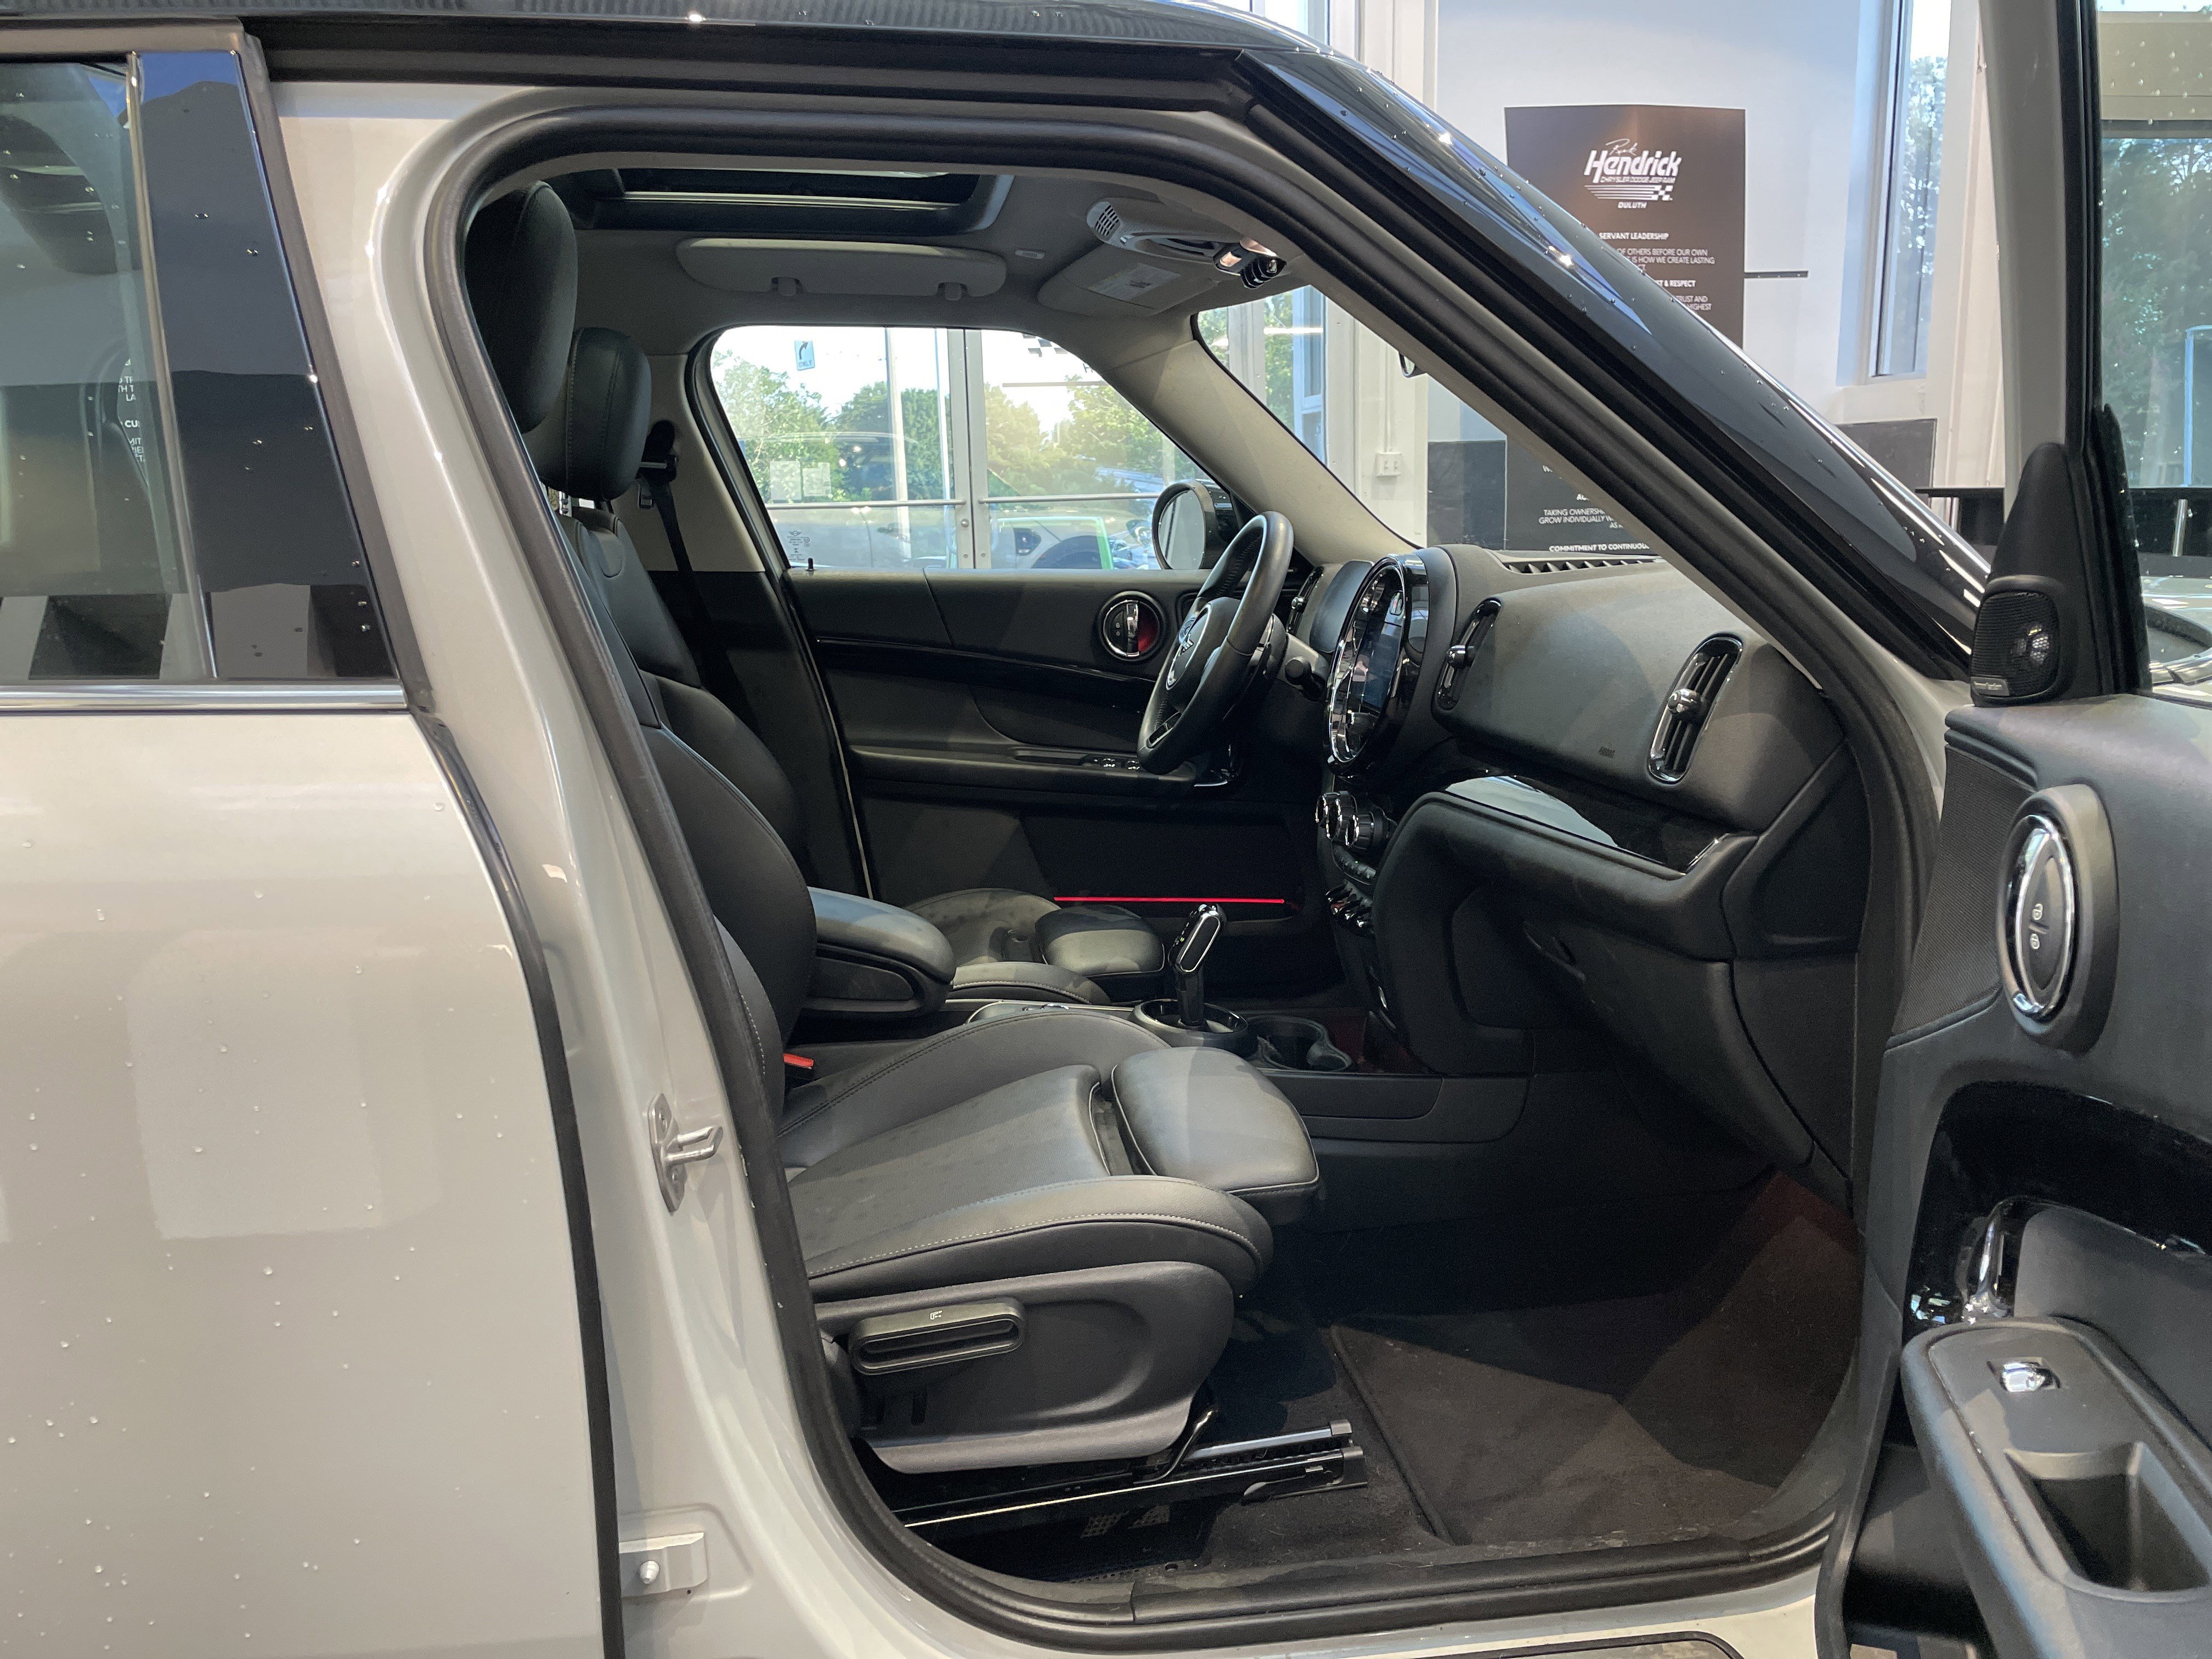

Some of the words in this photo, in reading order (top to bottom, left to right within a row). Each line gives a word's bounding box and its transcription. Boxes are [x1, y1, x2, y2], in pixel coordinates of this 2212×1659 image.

[1584, 150, 1683, 183] Hendrick
[1538, 516, 1562, 524] GROW
[1563, 515, 1605, 523] INDIVIDUALLY
[1549, 544, 1596, 552] COMMITMENT
